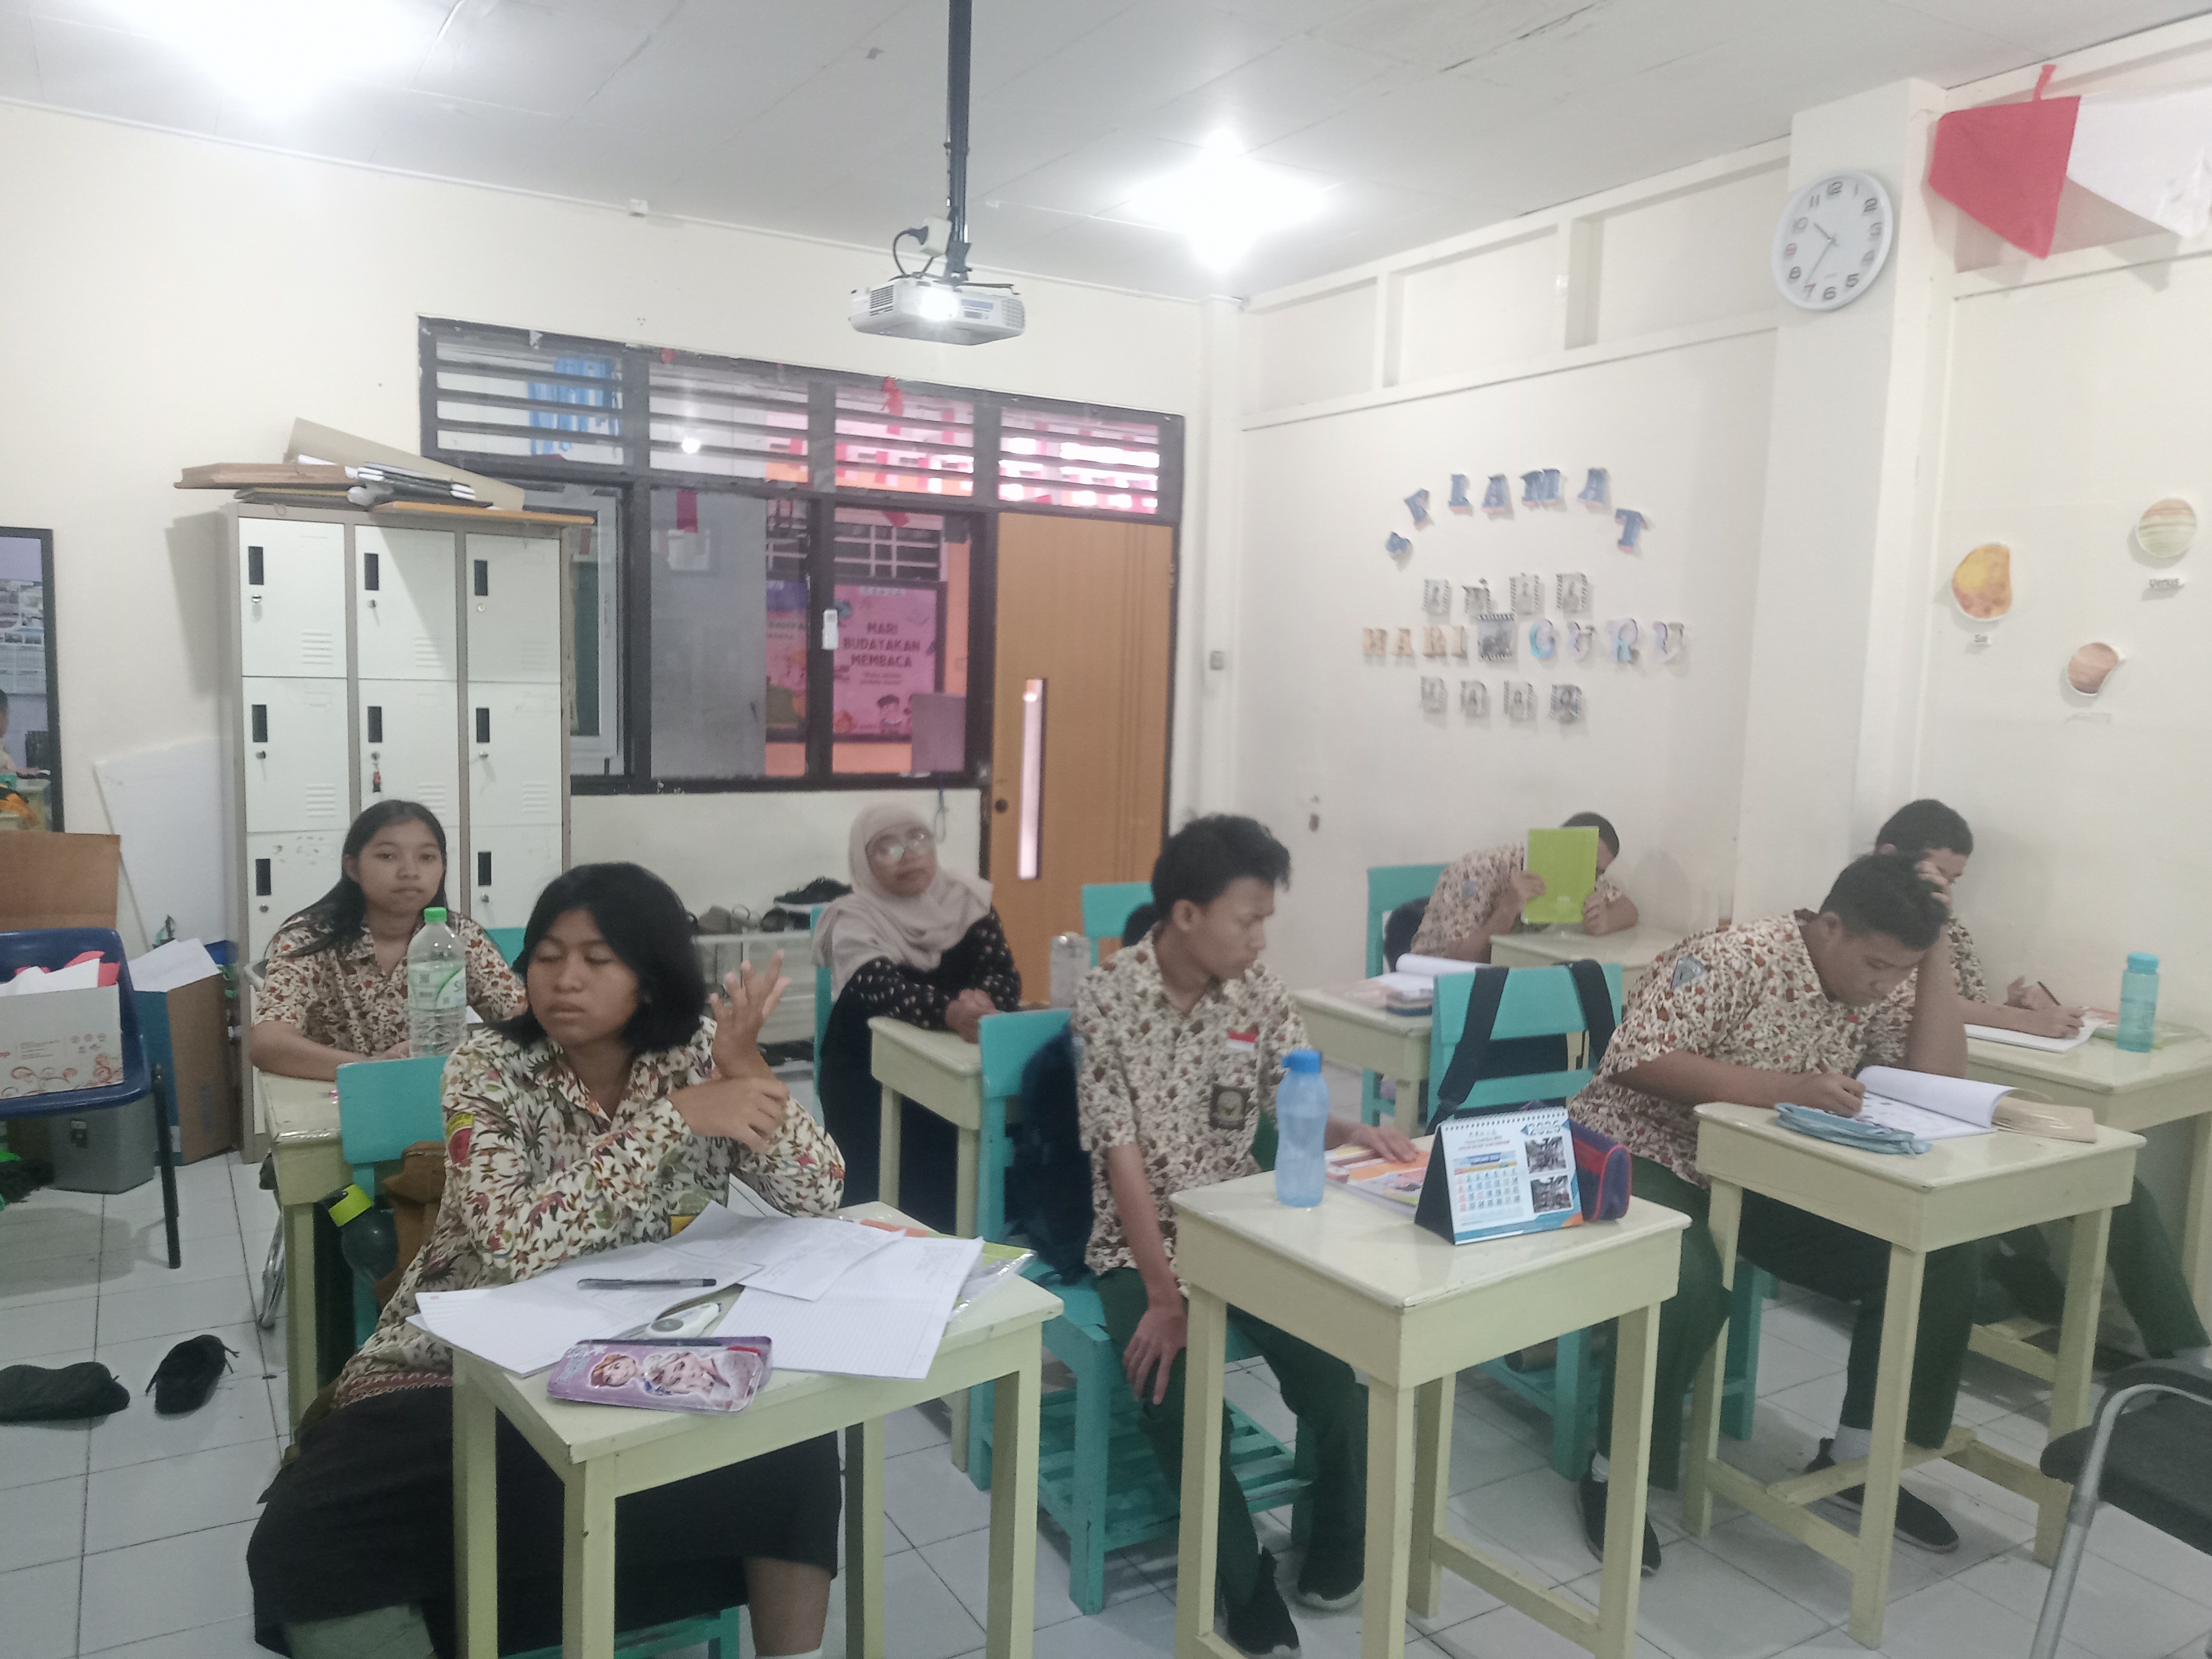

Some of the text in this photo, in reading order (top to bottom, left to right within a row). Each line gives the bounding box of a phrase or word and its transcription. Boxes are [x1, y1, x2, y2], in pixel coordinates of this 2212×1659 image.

[1864, 198, 1878, 212] 2
[1846, 273, 1859, 287] 5
[1804, 283, 1816, 298] 7
[1824, 287, 1836, 299] 6
[867, 622, 898, 634] MARI
[843, 638, 920, 651] BUDAYAKAN
[851, 654, 912, 667] MEMBACA
